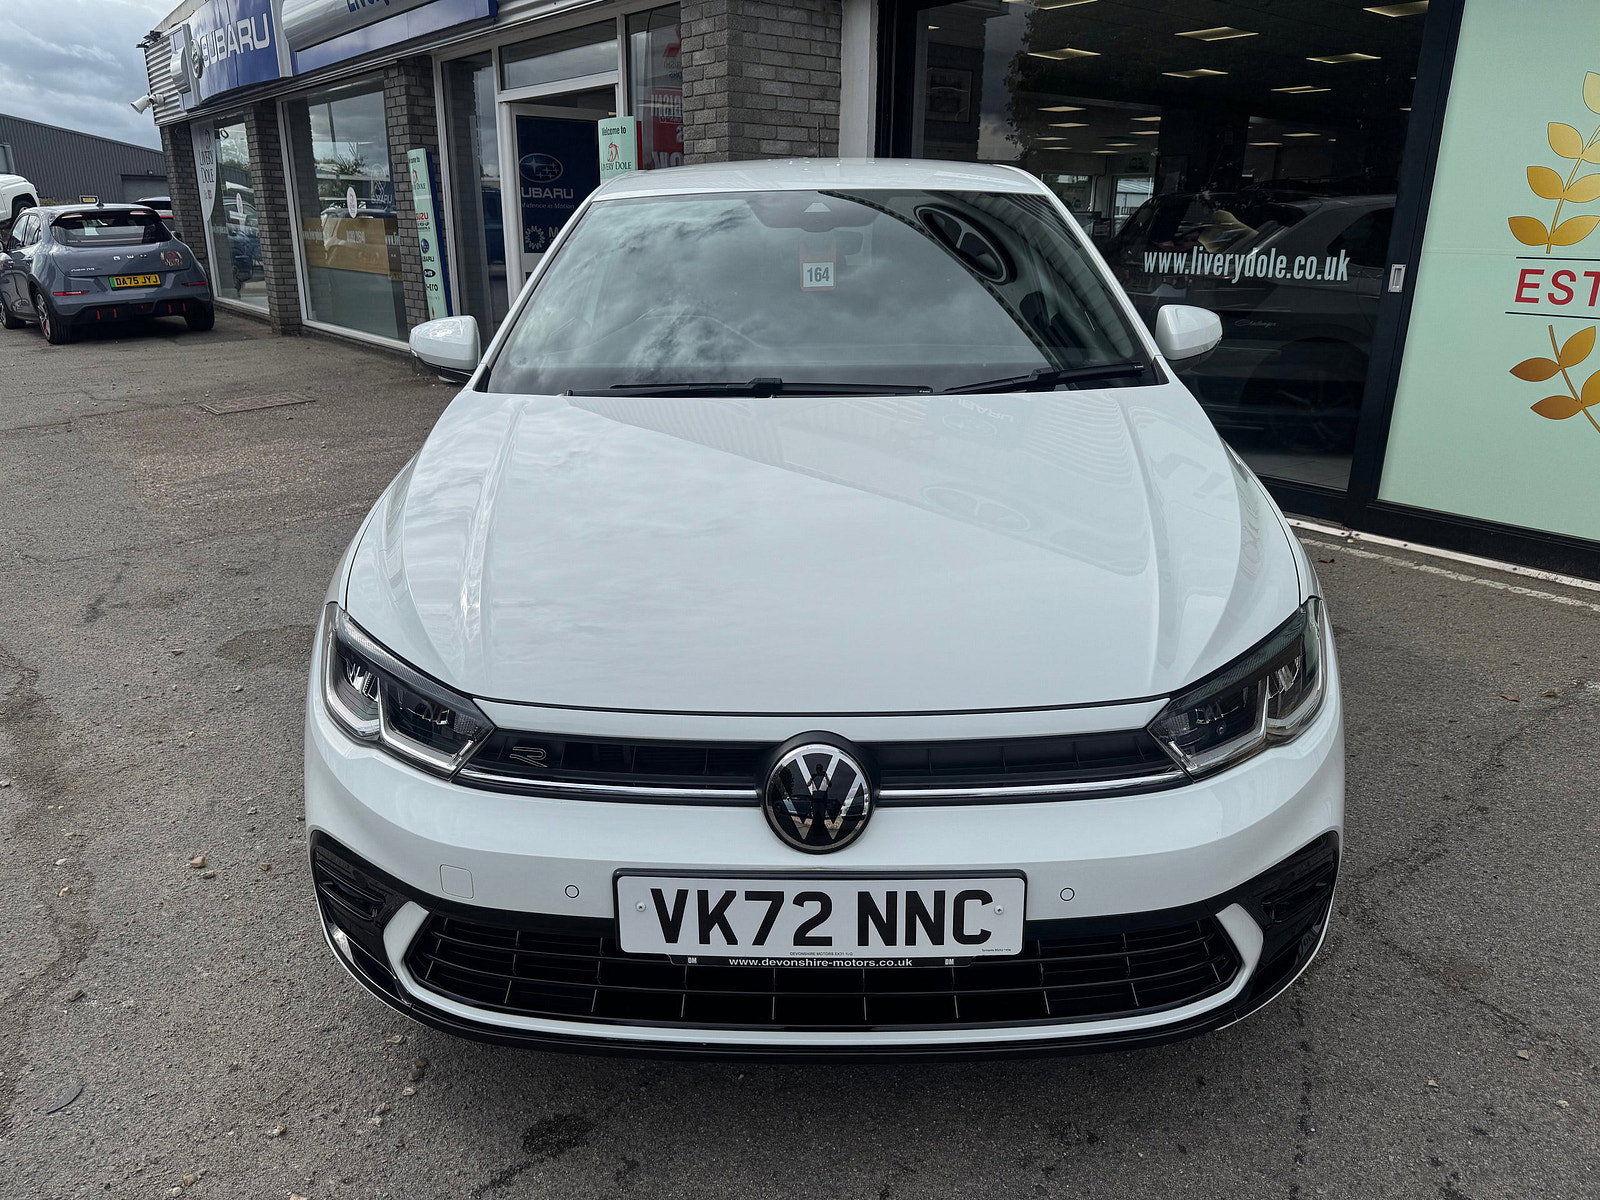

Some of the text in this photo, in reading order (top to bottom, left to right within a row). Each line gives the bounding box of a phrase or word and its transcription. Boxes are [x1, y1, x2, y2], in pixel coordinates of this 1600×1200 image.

[200, 13, 270, 68] SUBARU
[621, 125, 627, 135] to
[615, 161, 632, 170] DOLE
[521, 187, 574, 199] UBARU
[1143, 245, 1350, 284] www.liverydole.co.uk
[115, 275, 158, 286] DA75 JYJ
[806, 266, 830, 283] 164
[1515, 268, 1600, 307] EST
[650, 888, 994, 947] VK72 NNC
[729, 958, 913, 967] www.devonshire-motors.co.uk
